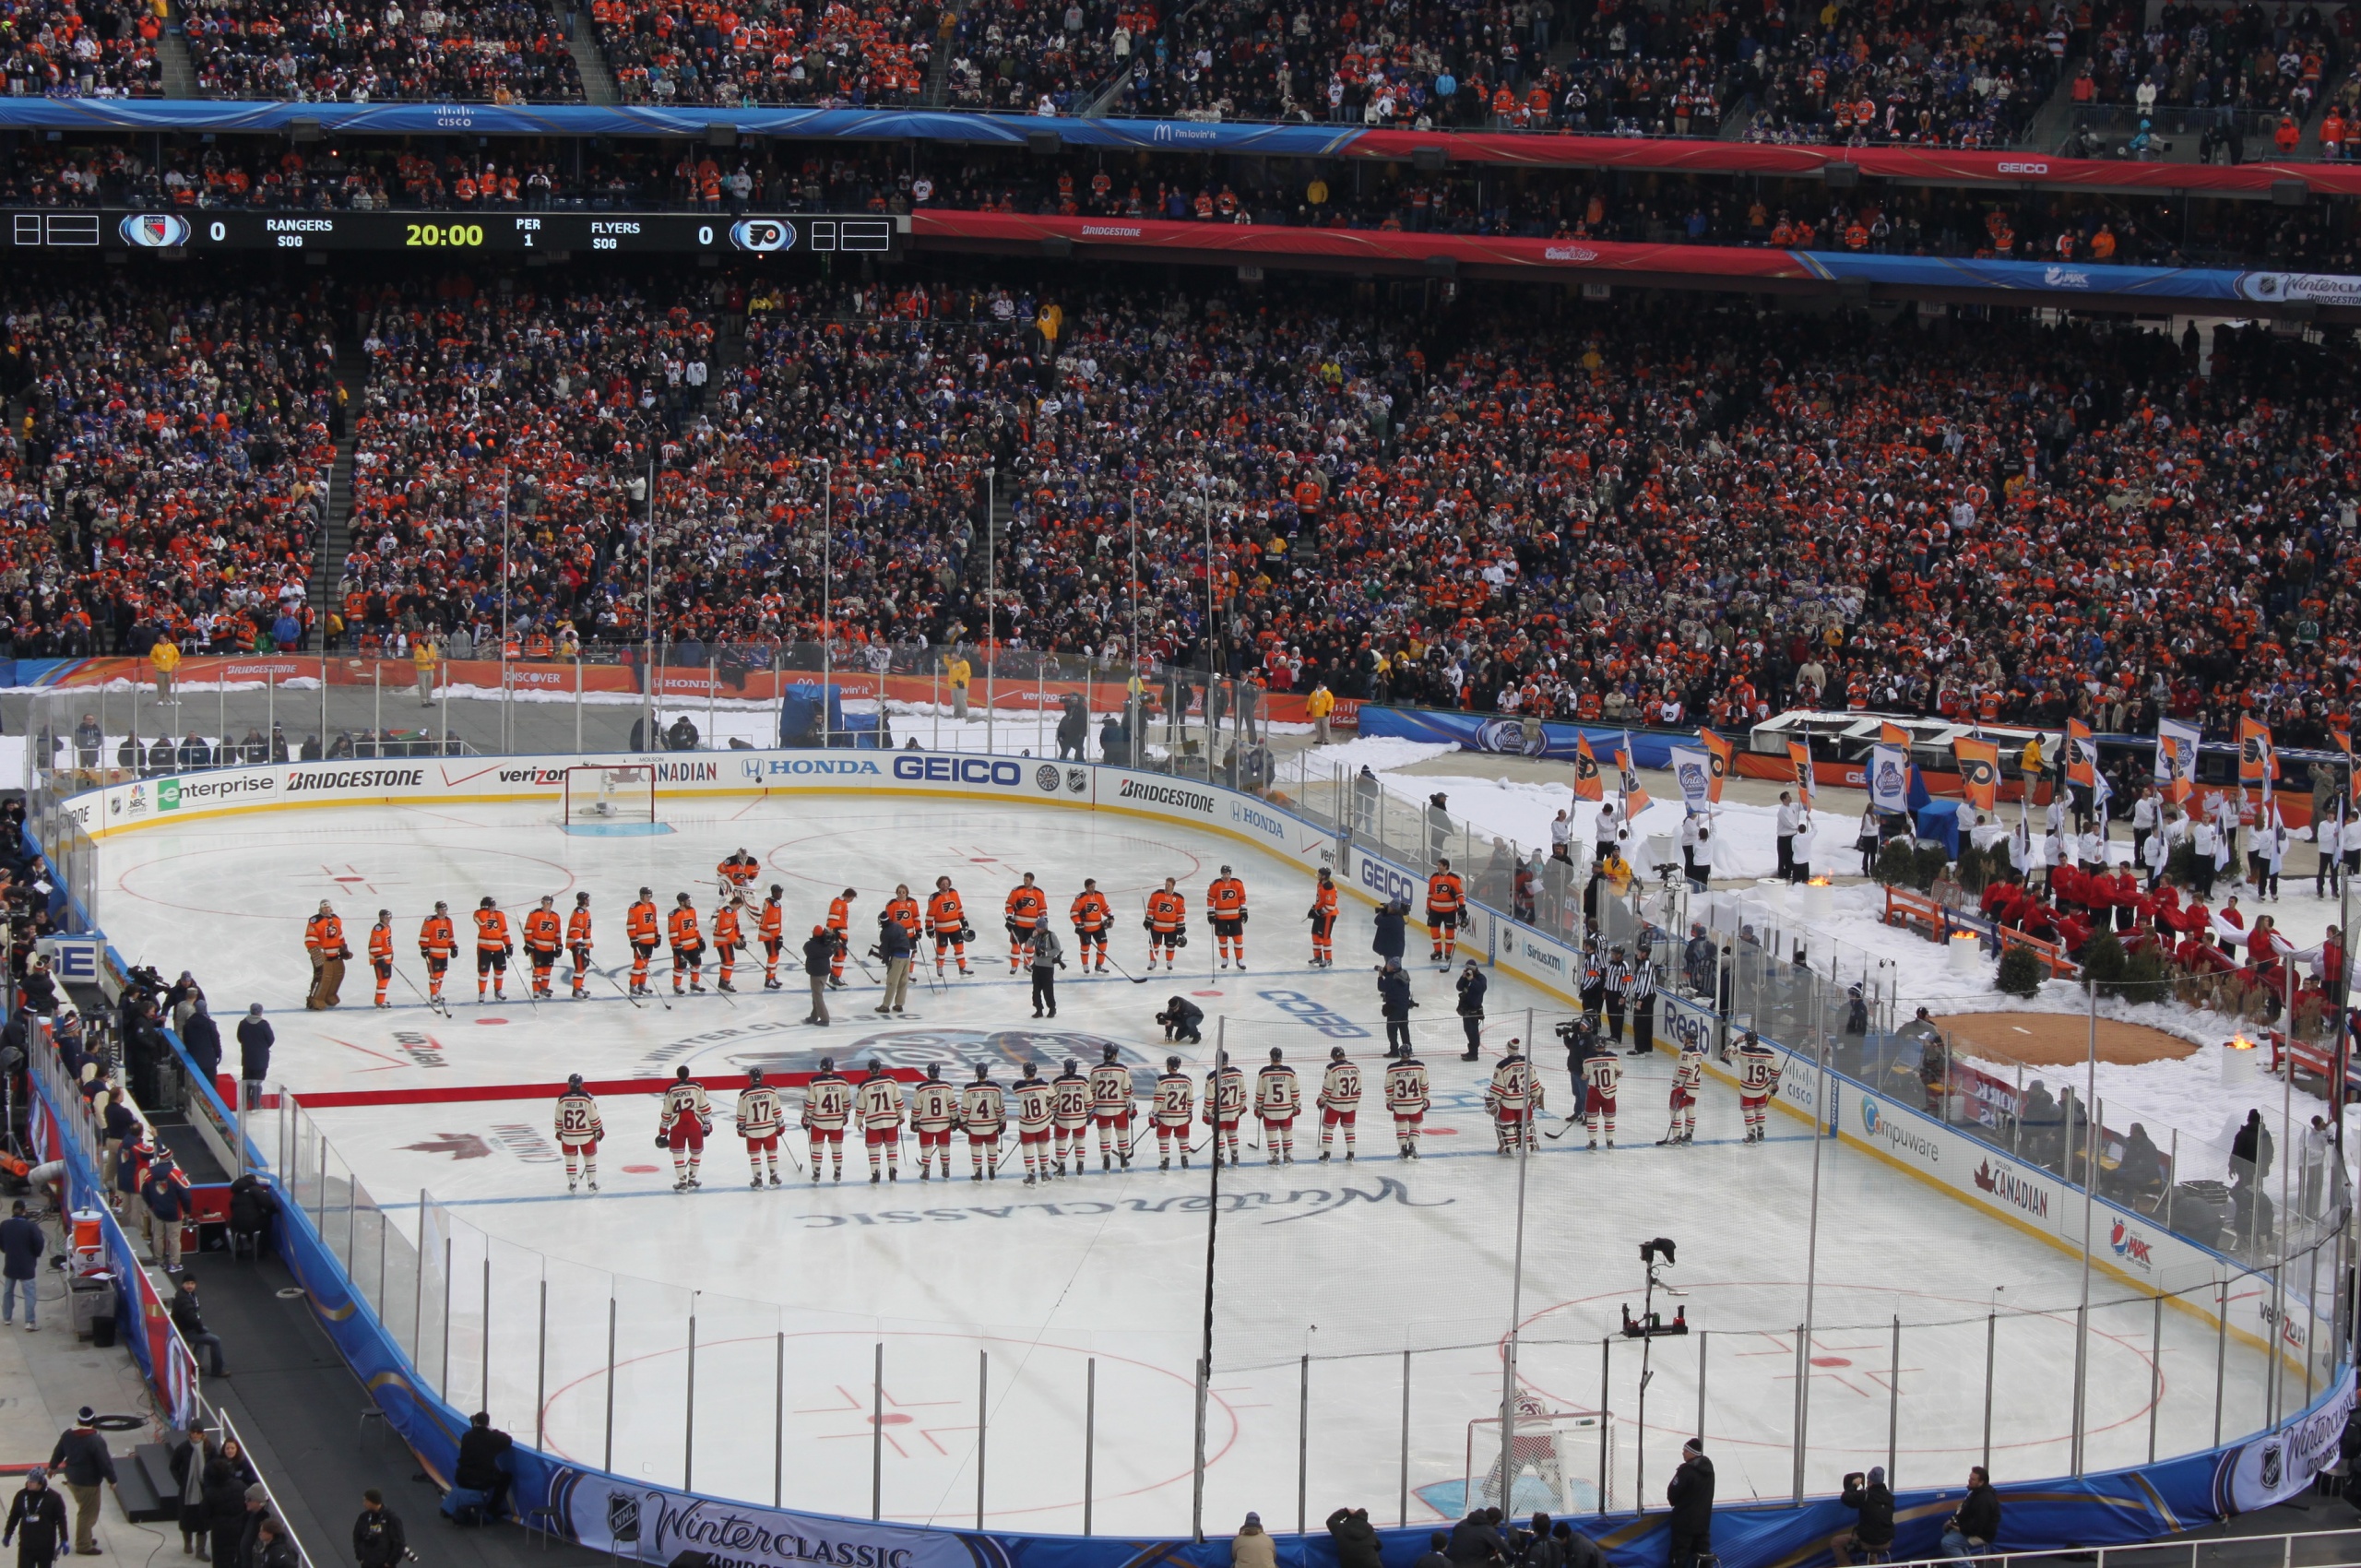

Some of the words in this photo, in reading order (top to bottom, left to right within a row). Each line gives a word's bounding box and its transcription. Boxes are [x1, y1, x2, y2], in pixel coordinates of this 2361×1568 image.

[437, 118, 472, 126] CISCO
[1175, 129, 1187, 138] i'm
[1188, 129, 1209, 138] lovin'
[1209, 130, 1216, 139] it
[1998, 162, 2047, 174] GEICO
[210, 222, 226, 241] 0
[267, 220, 333, 232] RANGERS
[406, 224, 482, 247] 20:00
[516, 219, 540, 231] PER
[591, 222, 641, 234] FLYERS
[1082, 225, 1141, 237] BRIDGESTONE
[278, 235, 303, 247] SOG
[524, 233, 534, 247] 1
[592, 238, 617, 249] SOG
[698, 227, 714, 245] 0
[2280, 273, 2339, 298] Winter
[227, 664, 298, 675] BRIDGESTONE
[504, 671, 561, 683] DISCOVER
[664, 679, 724, 690] HONDA
[861, 685, 870, 695] it
[768, 760, 882, 776] HONDA
[893, 755, 1022, 787] GEICO
[160, 776, 275, 802] enterprise
[286, 769, 424, 791] BRIDGESTONE
[130, 798, 147, 807] NBC
[1120, 778, 1215, 814] BRIDGESTONE
[1242, 807, 1285, 840] HONDA
[1361, 858, 1414, 908] GEICO
[1256, 990, 1373, 1039] GEICO
[391, 1030, 450, 1070] verizon
[640, 1028, 748, 1062] WINTER
[1593, 1068, 1611, 1088] 10
[1747, 1064, 1766, 1084] 19
[872, 1084, 885, 1092] RUPP
[928, 1088, 943, 1097] PRUST
[1097, 1079, 1119, 1099] 22
[1219, 1085, 1239, 1107] 27
[1273, 1084, 1285, 1104] 5
[1339, 1076, 1358, 1097] 32
[1395, 1077, 1419, 1099] 34
[1787, 1083, 1812, 1105] CISCO
[672, 1098, 695, 1114] 42
[749, 1093, 770, 1102] DUBINSKY
[821, 1093, 841, 1114] 41
[870, 1091, 891, 1113] 71
[930, 1097, 942, 1117] 8
[1061, 1093, 1083, 1113] 26
[1167, 1090, 1188, 1111] 24
[751, 1100, 770, 1123] 17
[976, 1099, 990, 1119] 4
[1023, 1098, 1042, 1119] 18
[564, 1109, 587, 1130] 62
[1863, 1096, 1939, 1162] Compuware
[490, 1123, 564, 1164] CANADIAN
[1994, 1159, 2012, 1173] MOLSON
[1120, 1176, 1455, 1225] Winter
[1994, 1169, 2047, 1219] CANADIAN
[794, 1201, 1115, 1229] CLASSIC
[2127, 1235, 2153, 1265] MAX
[2282, 1414, 2331, 1483] Winter
[2264, 1455, 2281, 1483] NHL
[613, 1506, 637, 1529] NHL
[645, 1491, 774, 1554] Winter
[773, 1533, 913, 1568] CLASSIC
